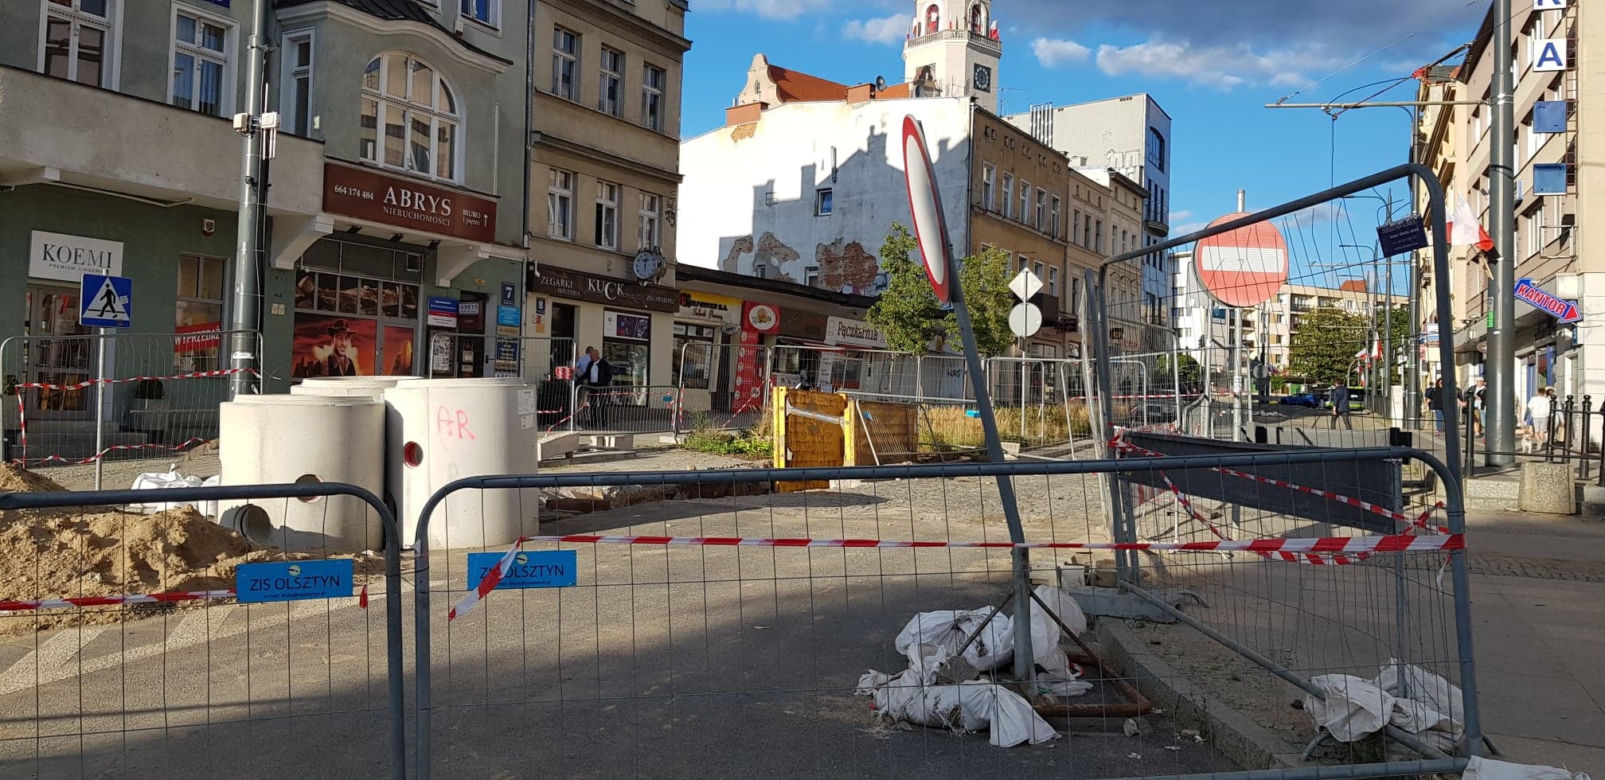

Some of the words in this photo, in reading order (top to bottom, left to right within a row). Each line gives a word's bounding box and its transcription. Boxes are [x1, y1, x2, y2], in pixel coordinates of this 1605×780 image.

[334, 184, 347, 195] 664
[348, 187, 360, 198] 174
[383, 186, 452, 216] ABRYS
[42, 243, 113, 268] KOEMI
[540, 275, 574, 289] ZEGARKI
[588, 278, 625, 301] KUCK
[505, 286, 513, 299] 7
[1517, 283, 1567, 316] KANTOR
[538, 301, 544, 310] 8
[249, 578, 271, 592] ZIS
[274, 574, 341, 591] OLSZTYN
